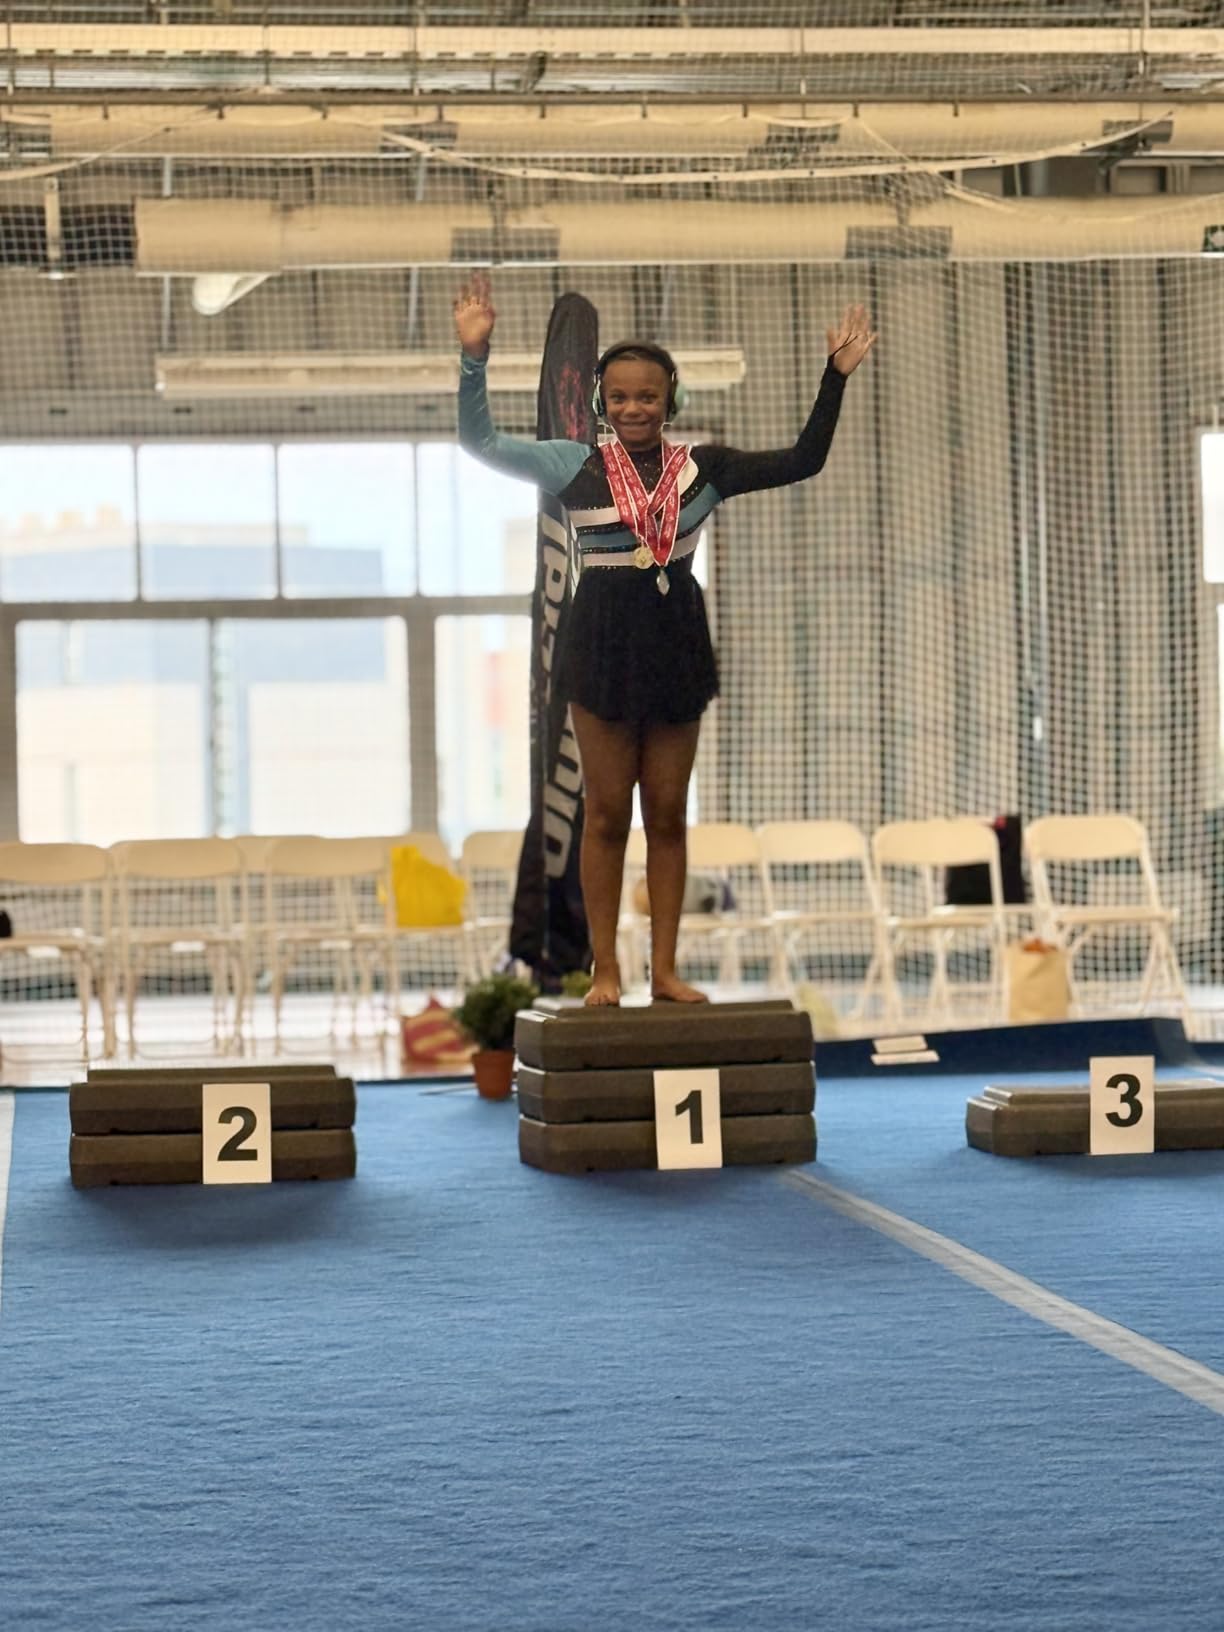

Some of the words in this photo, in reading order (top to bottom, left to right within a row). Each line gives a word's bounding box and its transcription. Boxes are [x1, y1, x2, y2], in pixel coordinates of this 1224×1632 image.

[674, 1090, 704, 1144] 1
[1105, 1073, 1143, 1128] 3
[217, 1106, 258, 1162] 2
